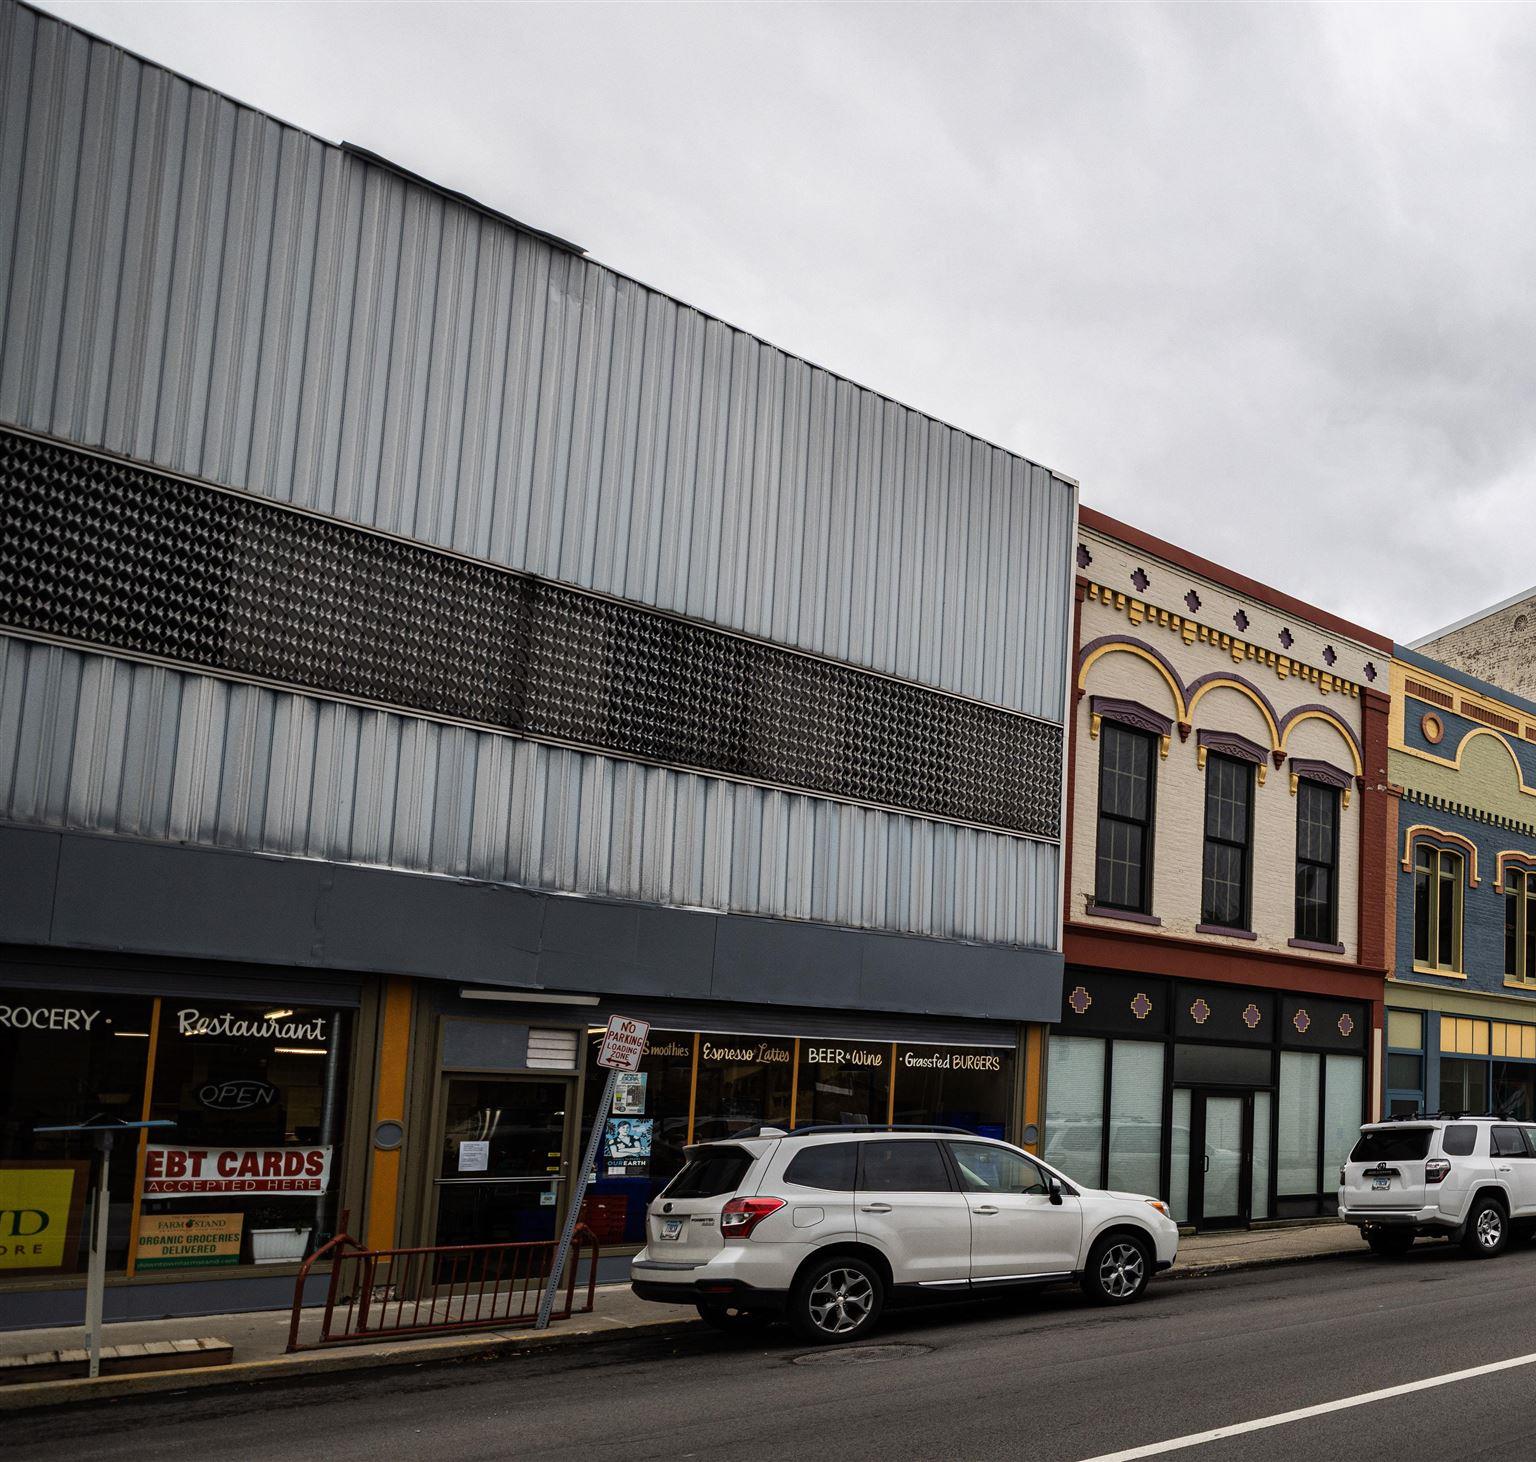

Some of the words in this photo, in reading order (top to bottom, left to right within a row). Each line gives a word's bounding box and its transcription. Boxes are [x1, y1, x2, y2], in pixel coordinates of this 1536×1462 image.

[177, 1009, 326, 1040] Restaurant
[621, 1022, 636, 1033] NO
[607, 1031, 642, 1047] PARKING
[607, 1043, 637, 1055] LOADING
[611, 1051, 630, 1060] ZONE
[642, 1040, 689, 1056] Smoothies
[703, 1042, 754, 1061] Espresso
[756, 1043, 790, 1063] Lattes
[808, 1048, 845, 1064] BEER
[852, 1050, 882, 1066] Wine
[905, 1052, 950, 1069] Grassfed
[953, 1055, 1000, 1071] BURGERS
[200, 1085, 274, 1103] OPEN
[146, 1151, 208, 1178] EBT
[217, 1151, 324, 1177] CARDS
[148, 1180, 256, 1192] ACCEPTED
[267, 1179, 317, 1190] HERE
[158, 1221, 184, 1229] FARM
[194, 1219, 226, 1228] STAND
[139, 1235, 183, 1246] ORGANIC
[186, 1233, 240, 1244] GROCERIES
[162, 1245, 216, 1255] DELIVERED
